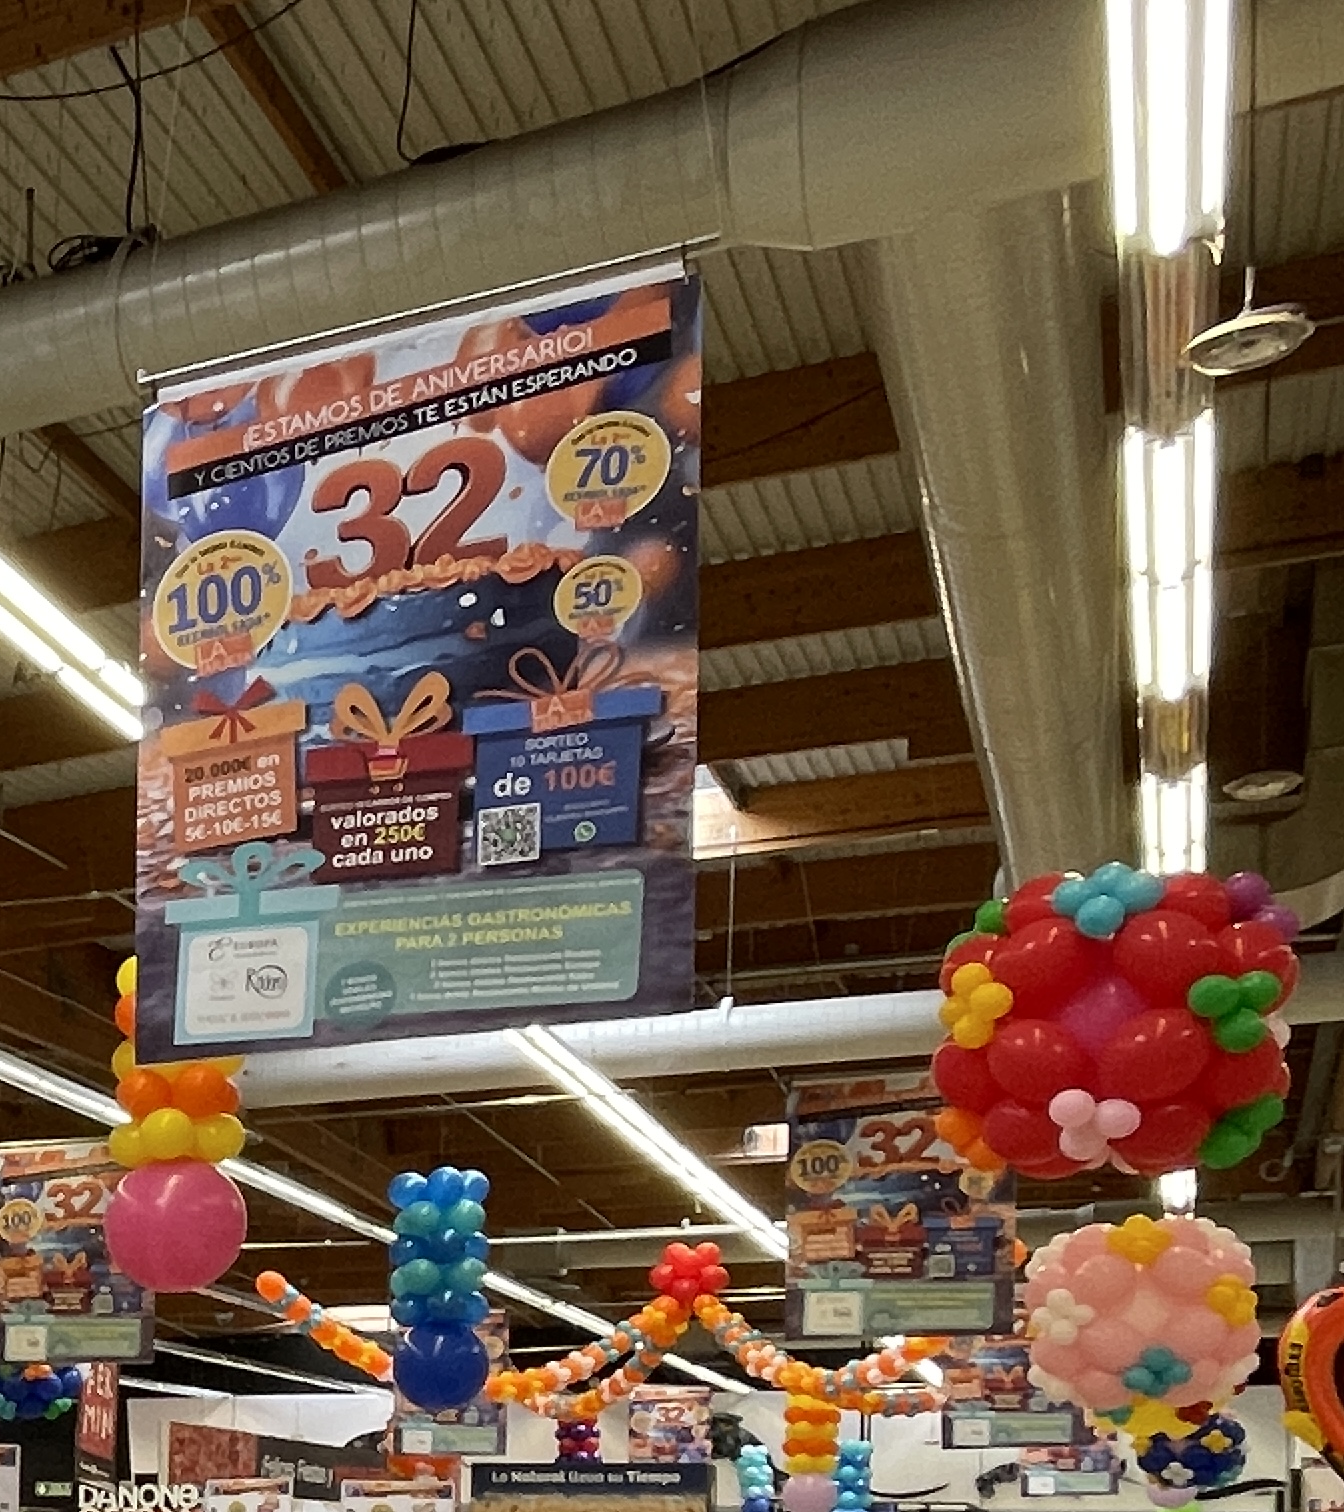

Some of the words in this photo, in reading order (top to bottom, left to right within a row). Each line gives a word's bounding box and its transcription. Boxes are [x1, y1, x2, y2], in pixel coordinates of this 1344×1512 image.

[370, 384, 403, 412] DE
[412, 327, 593, 400] ANIVERSARIO!
[195, 471, 206, 487] Y
[211, 449, 290, 482] CIENTOS
[295, 438, 319, 457] DE
[325, 413, 409, 450] PREMIOS
[413, 403, 440, 425] TE
[445, 385, 507, 417] ESTÁN
[512, 349, 637, 398] ESPERANDO
[307, 436, 508, 590] 32
[257, 754, 280, 768] en
[188, 770, 276, 802] PREMIOS
[493, 771, 532, 798] de
[544, 760, 617, 791] 100€
[184, 789, 282, 823] DIRECTOS
[331, 805, 439, 829] valorados
[341, 832, 368, 848] en
[373, 823, 426, 845] 250€
[333, 847, 383, 868] cada
[391, 846, 434, 862] uno
[334, 913, 463, 937] EXPERIENCIAS
[395, 934, 443, 951] PARA
[462, 925, 563, 946] PERSONAS
[858, 1117, 940, 1168] 32
[44, 1181, 105, 1222] 32
[627, 1471, 682, 1486] Tiempo
